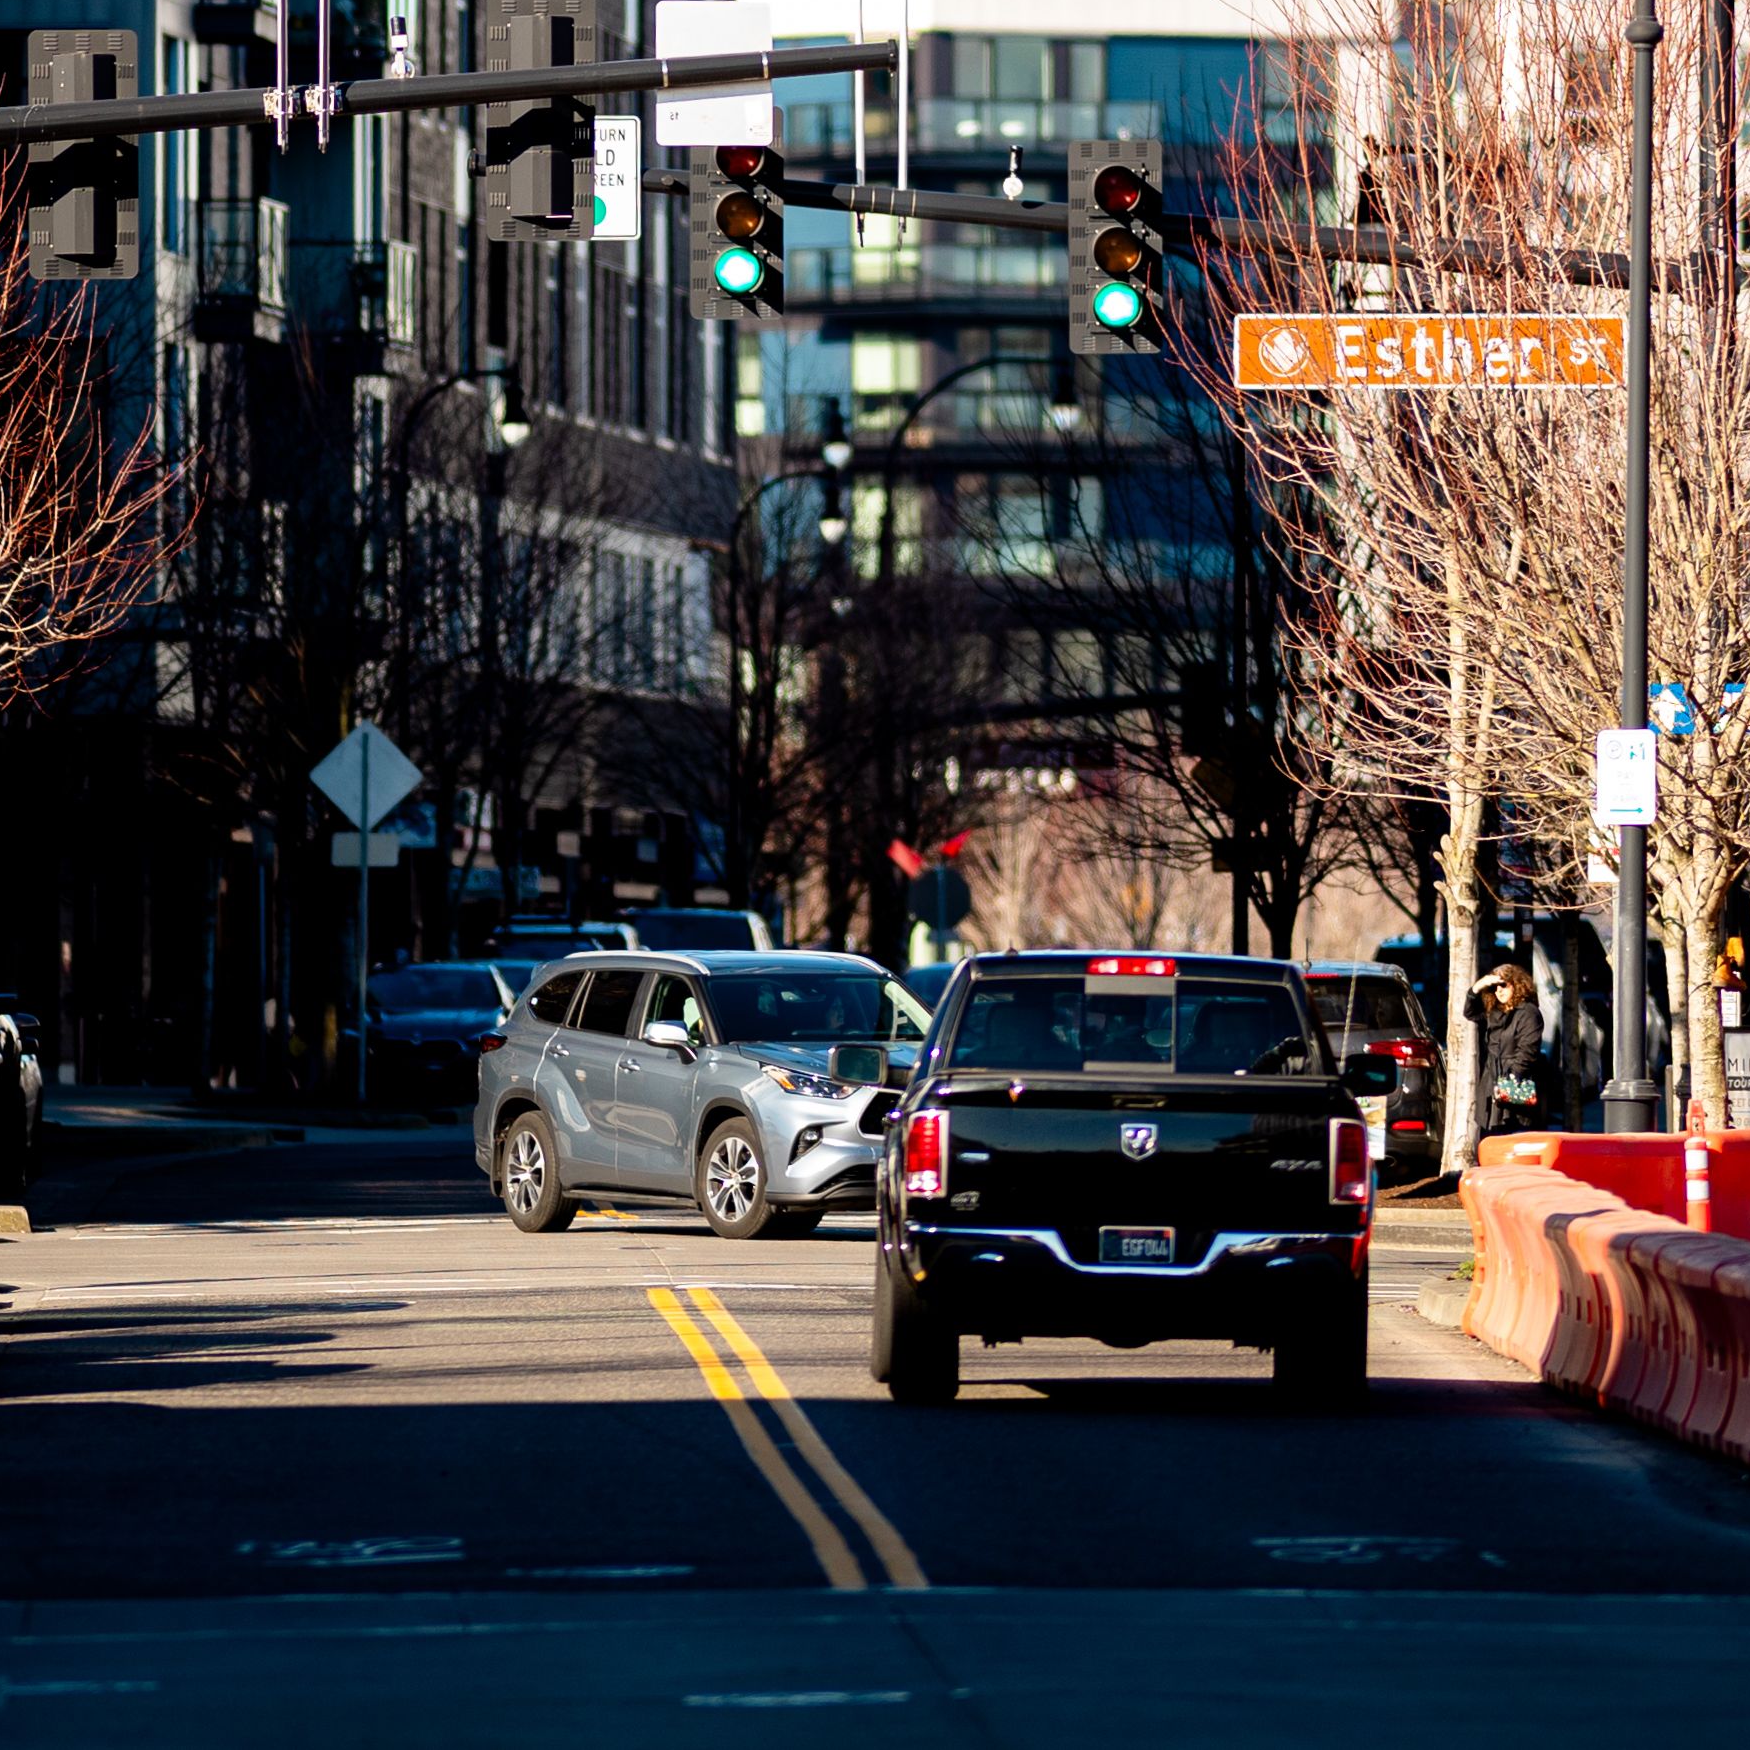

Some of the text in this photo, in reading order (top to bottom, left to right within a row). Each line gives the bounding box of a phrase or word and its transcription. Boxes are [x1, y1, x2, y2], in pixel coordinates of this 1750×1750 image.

[595, 173, 625, 187] REEN
[1334, 325, 1543, 380] Esther
[1732, 1098, 1747, 1108] EET
